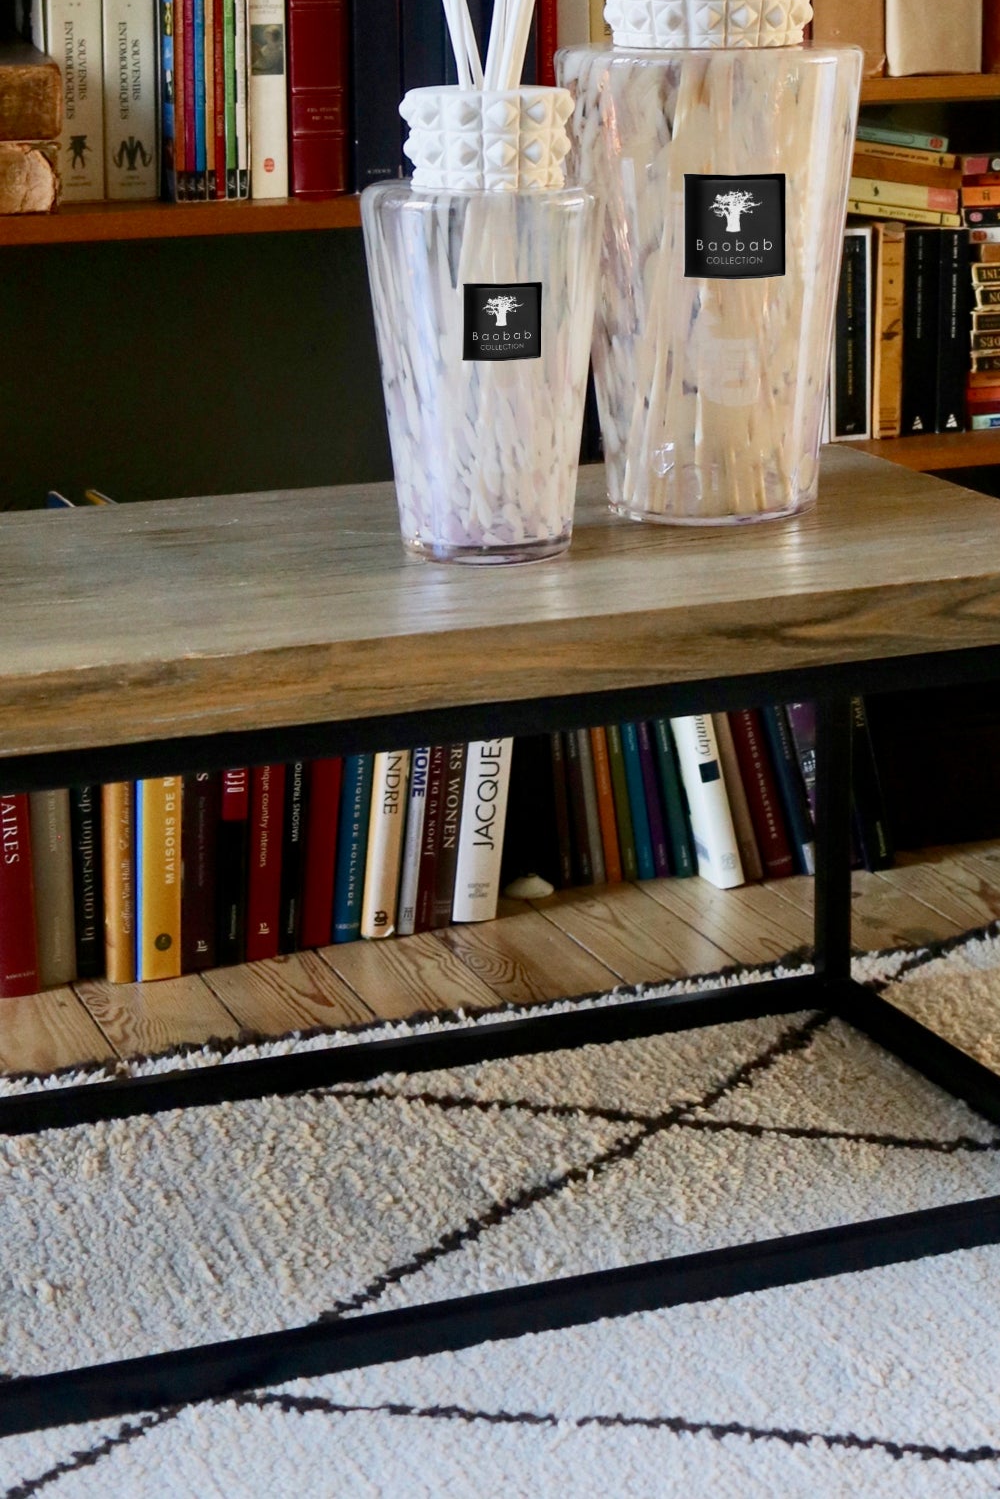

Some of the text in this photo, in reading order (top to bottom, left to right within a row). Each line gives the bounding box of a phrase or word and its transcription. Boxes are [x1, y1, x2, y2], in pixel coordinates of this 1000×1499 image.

[64, 20, 75, 121] ENTOMOLOGIQUES
[78, 39, 87, 101] SOUVENIRS
[118, 20, 129, 121] ENTOMOLOGIQUES
[131, 39, 141, 102] SOUVENIRS
[696, 238, 773, 252] Baobab
[706, 256, 763, 265] COLLECTION
[472, 330, 532, 341] Baobab
[480, 343, 524, 351] COLLECTION
[258, 792, 272, 867] country interiors
[291, 803, 299, 843] MAISONS
[424, 778, 440, 855] JAPON VU DE
[442, 777, 460, 849] WONEN
[754, 762, 778, 840] D'ANGLETERRE
[78, 787, 95, 920] conversation des
[164, 792, 175, 884] MAISONS DE
[347, 823, 360, 907] DE HOLLANDE
[121, 882, 132, 899] Van
